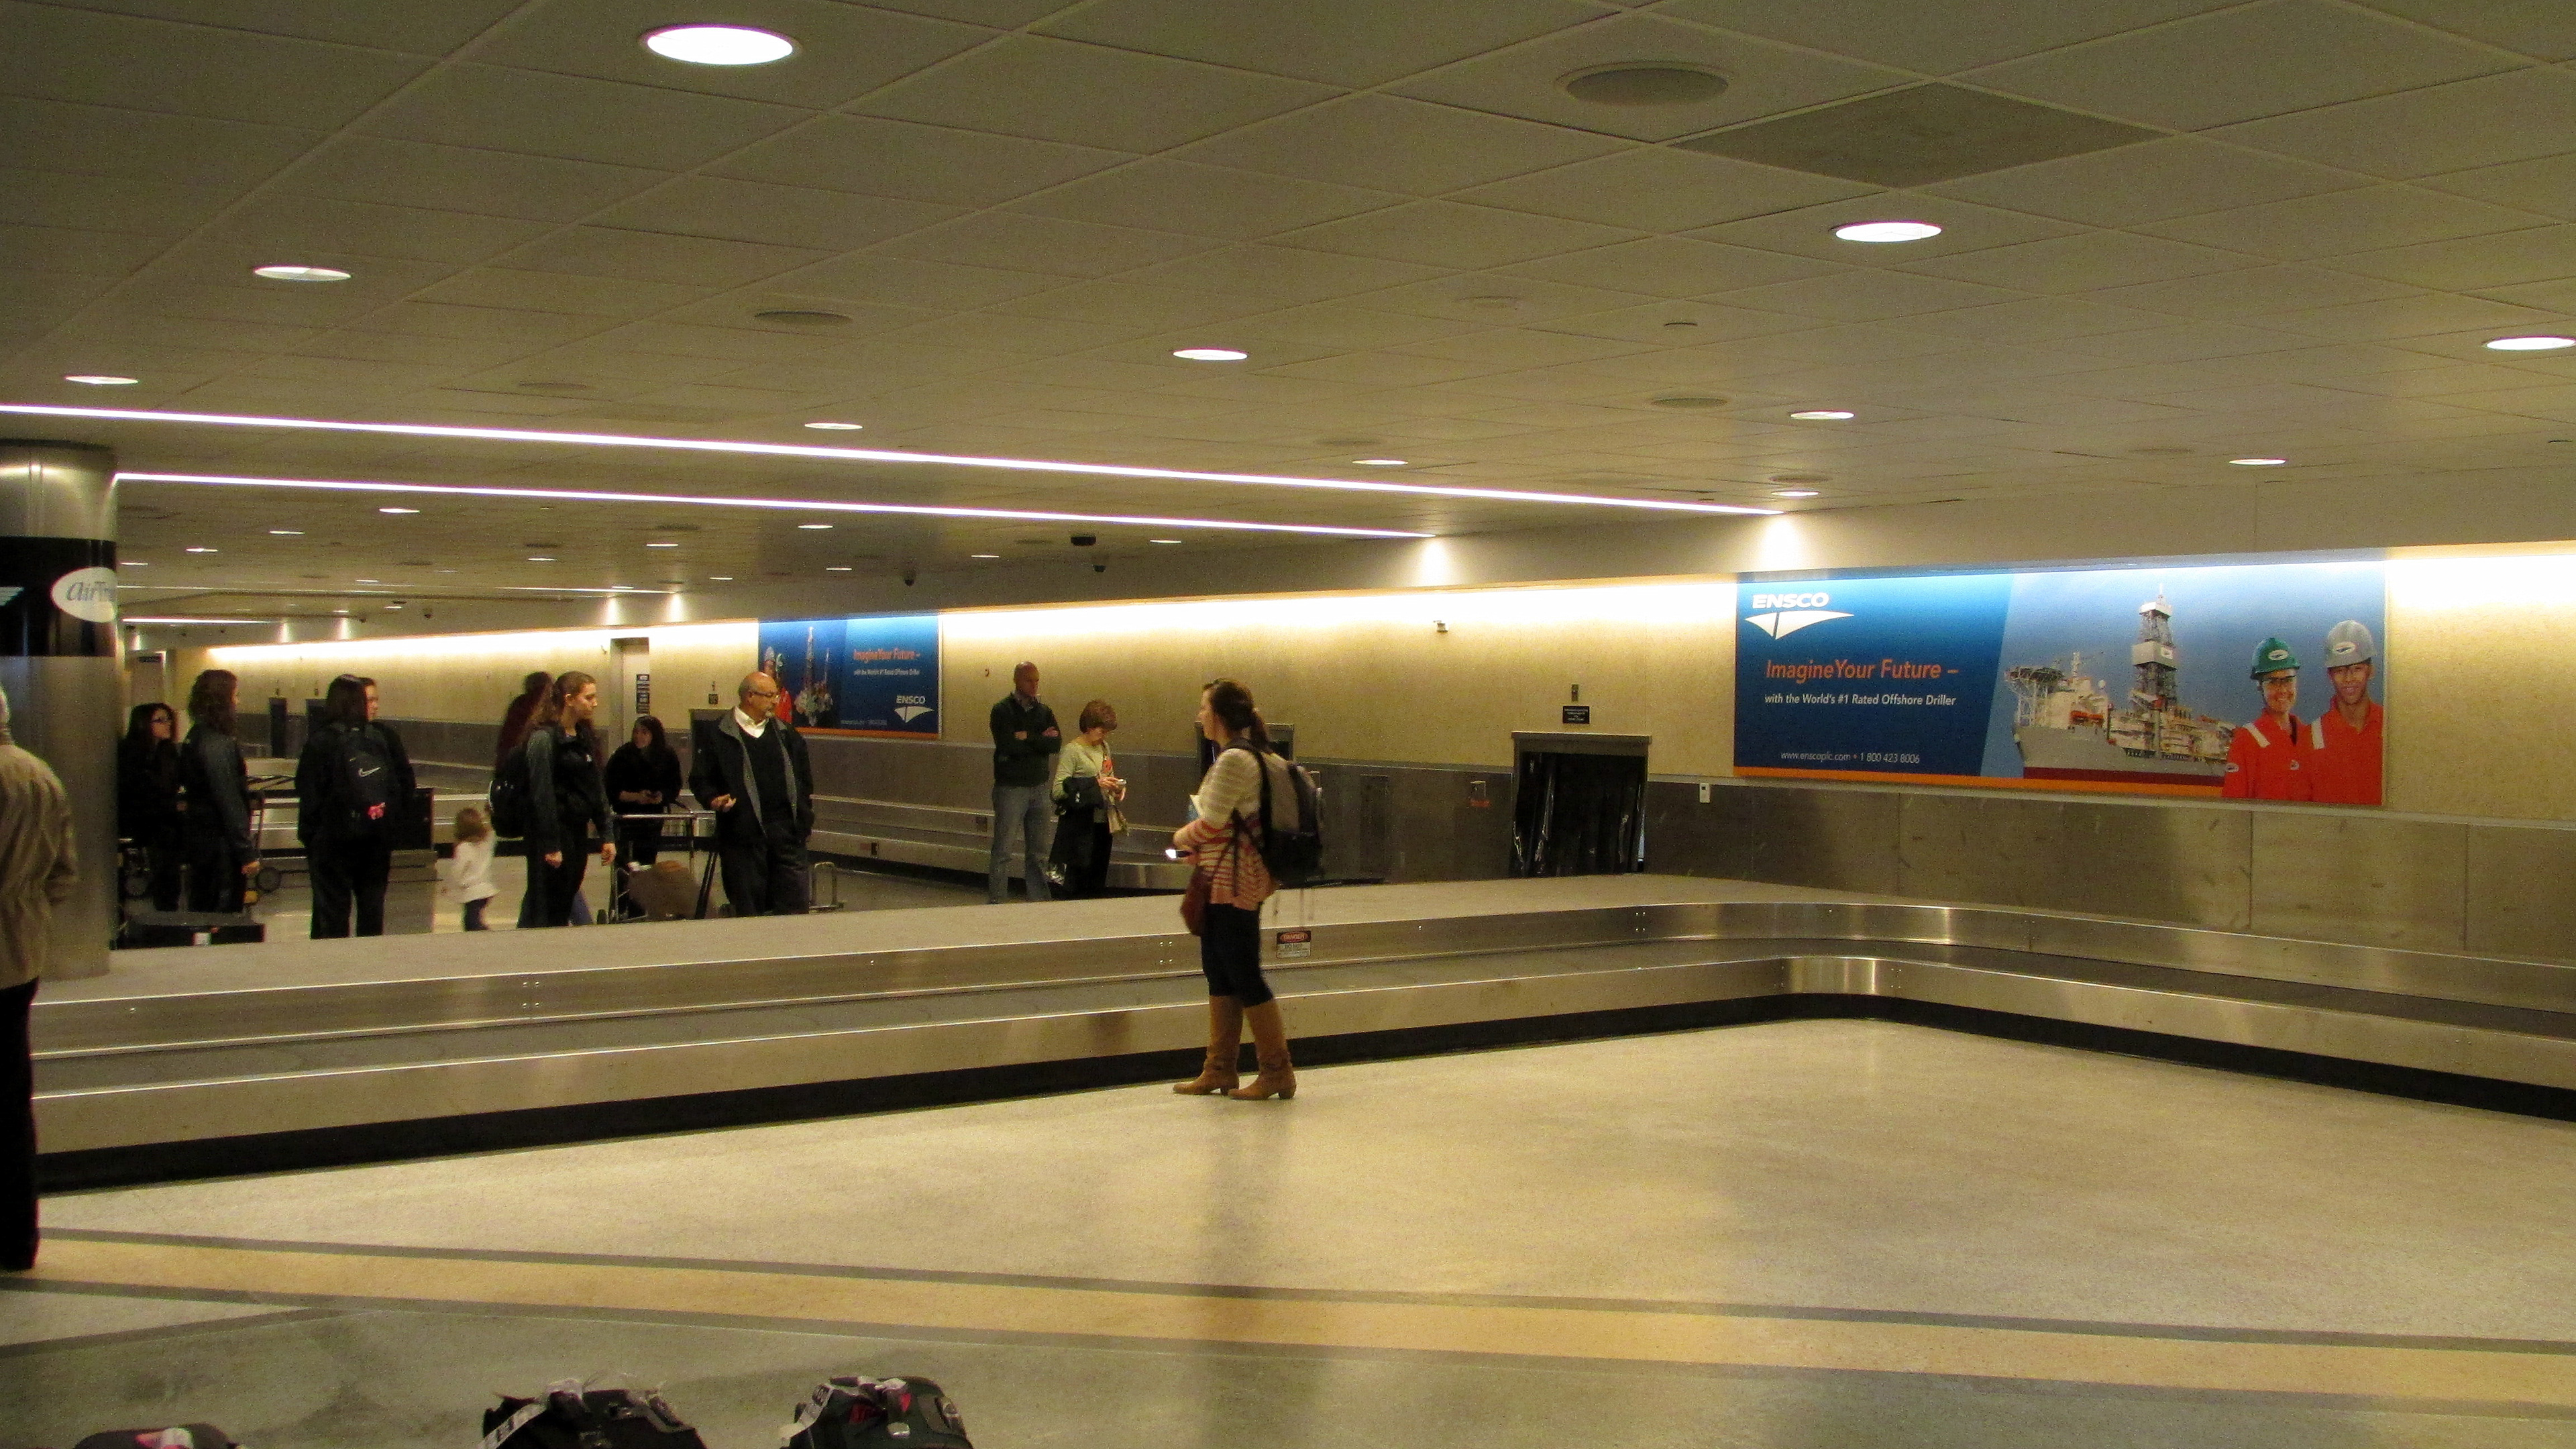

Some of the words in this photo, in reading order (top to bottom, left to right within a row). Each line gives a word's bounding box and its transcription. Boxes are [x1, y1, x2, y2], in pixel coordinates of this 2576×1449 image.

[1752, 592, 1829, 608] ENSCO
[1766, 659, 1834, 684] Imagine
[1835, 659, 1876, 679] Your
[1880, 659, 1941, 679] Future
[896, 695, 926, 704] ENSCO
[1764, 693, 1783, 704] with
[1785, 693, 1800, 704] the
[1802, 692, 1835, 704] World's
[1837, 693, 1849, 704] #1
[1851, 693, 1879, 704] Rated
[1881, 693, 1923, 705] Offshore
[1925, 694, 1957, 706] Driller
[1780, 751, 1851, 762] www.enscoplc.com
[1860, 753, 1864, 761] 1
[1866, 753, 1881, 762] 800
[1882, 753, 1898, 763] 423
[1900, 753, 1920, 763] 8006
